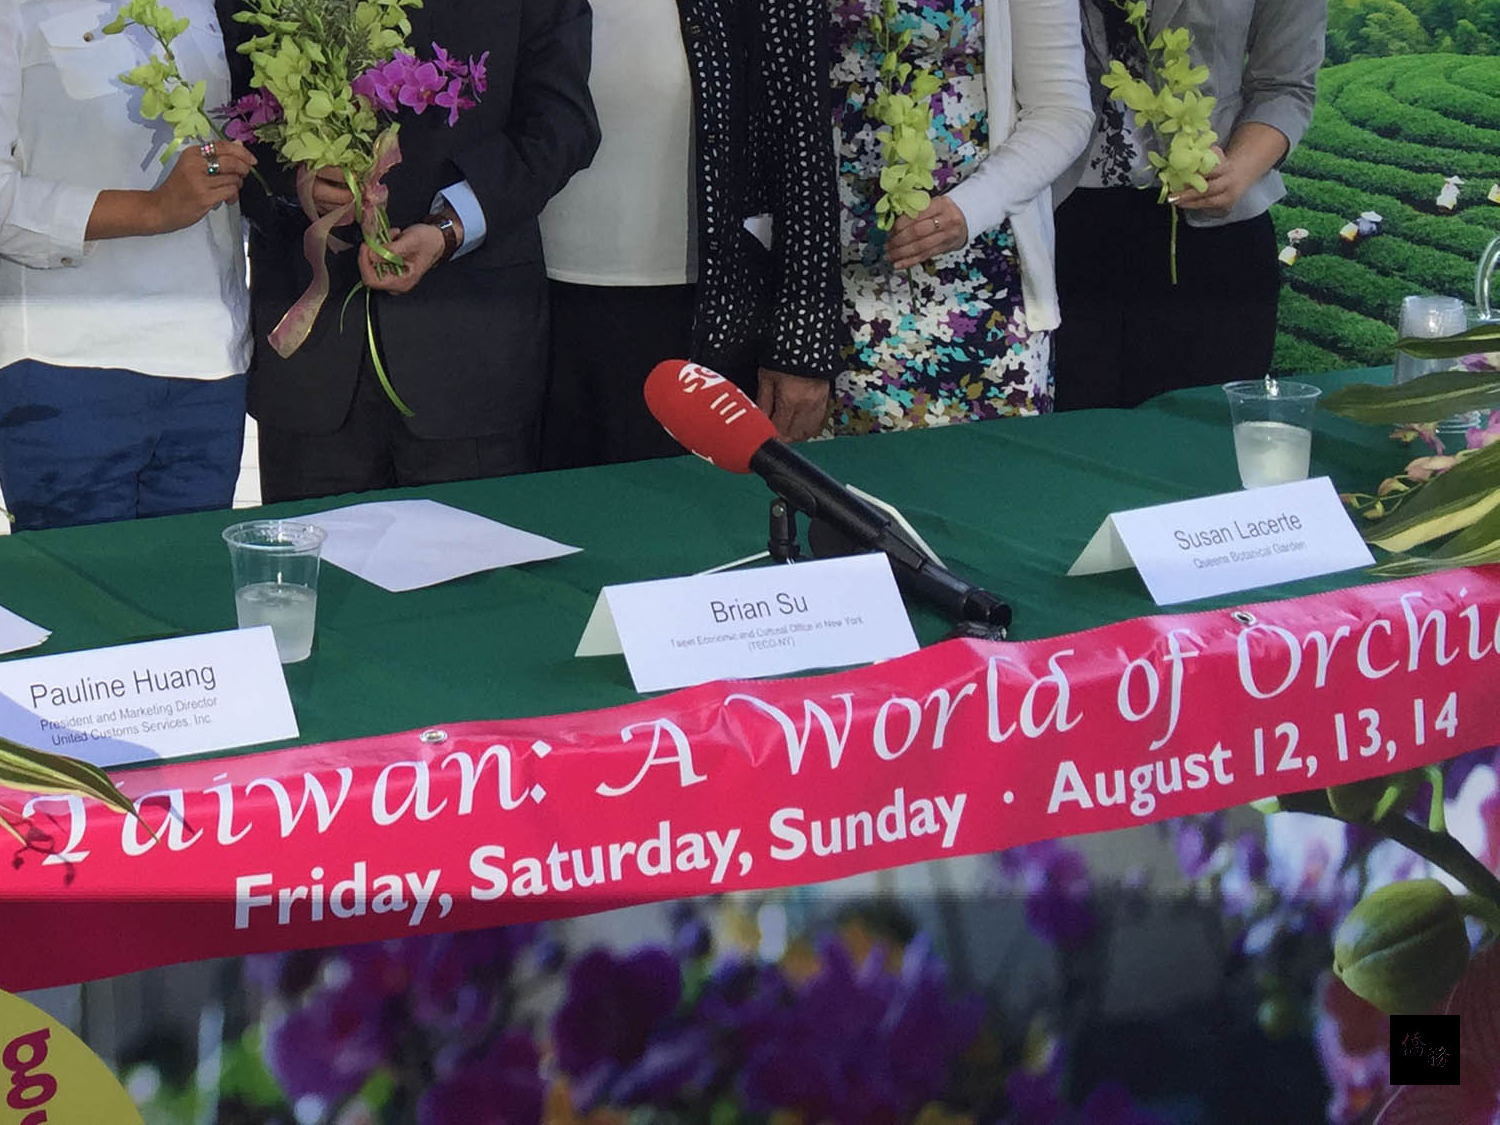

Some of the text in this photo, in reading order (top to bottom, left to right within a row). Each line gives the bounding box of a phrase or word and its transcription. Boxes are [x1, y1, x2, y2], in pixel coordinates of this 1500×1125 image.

[1174, 512, 1303, 551] Susan Lacerte
[1229, 546, 1272, 562] Botanical
[1272, 540, 1306, 555] Garden
[710, 593, 809, 623] Brian Su
[30, 665, 217, 709] Pauline Huang
[40, 696, 218, 731] President and Marketing Director
[22, 736, 552, 866] Taiwan:
[595, 717, 707, 797] A
[724, 649, 1084, 776] World
[1117, 628, 1200, 751] of
[51, 732, 89, 746] United
[90, 724, 140, 740] Customs
[233, 691, 1459, 930] Friday, Saturday, Sunday August 12, 13, 14
